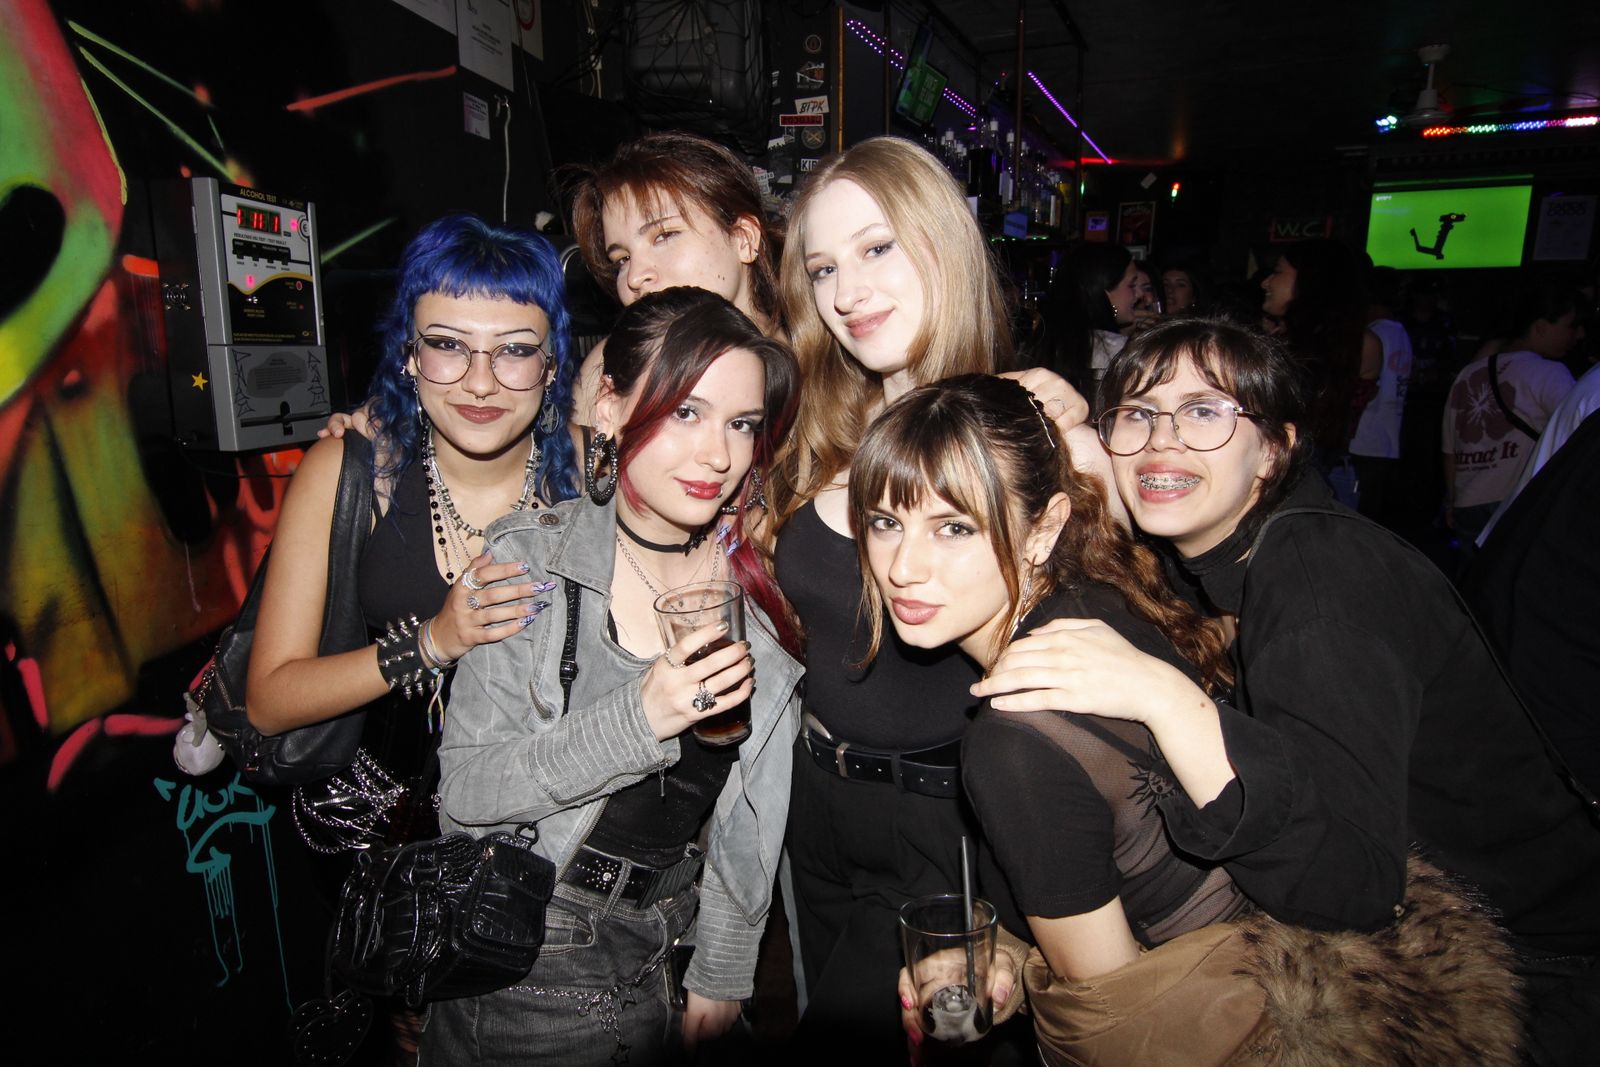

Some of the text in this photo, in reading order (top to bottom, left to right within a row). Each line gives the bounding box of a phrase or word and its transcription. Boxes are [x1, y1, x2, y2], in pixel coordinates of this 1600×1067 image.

[240, 188, 277, 203] ALCOHOL TEST
[1500, 441, 1519, 459] It
